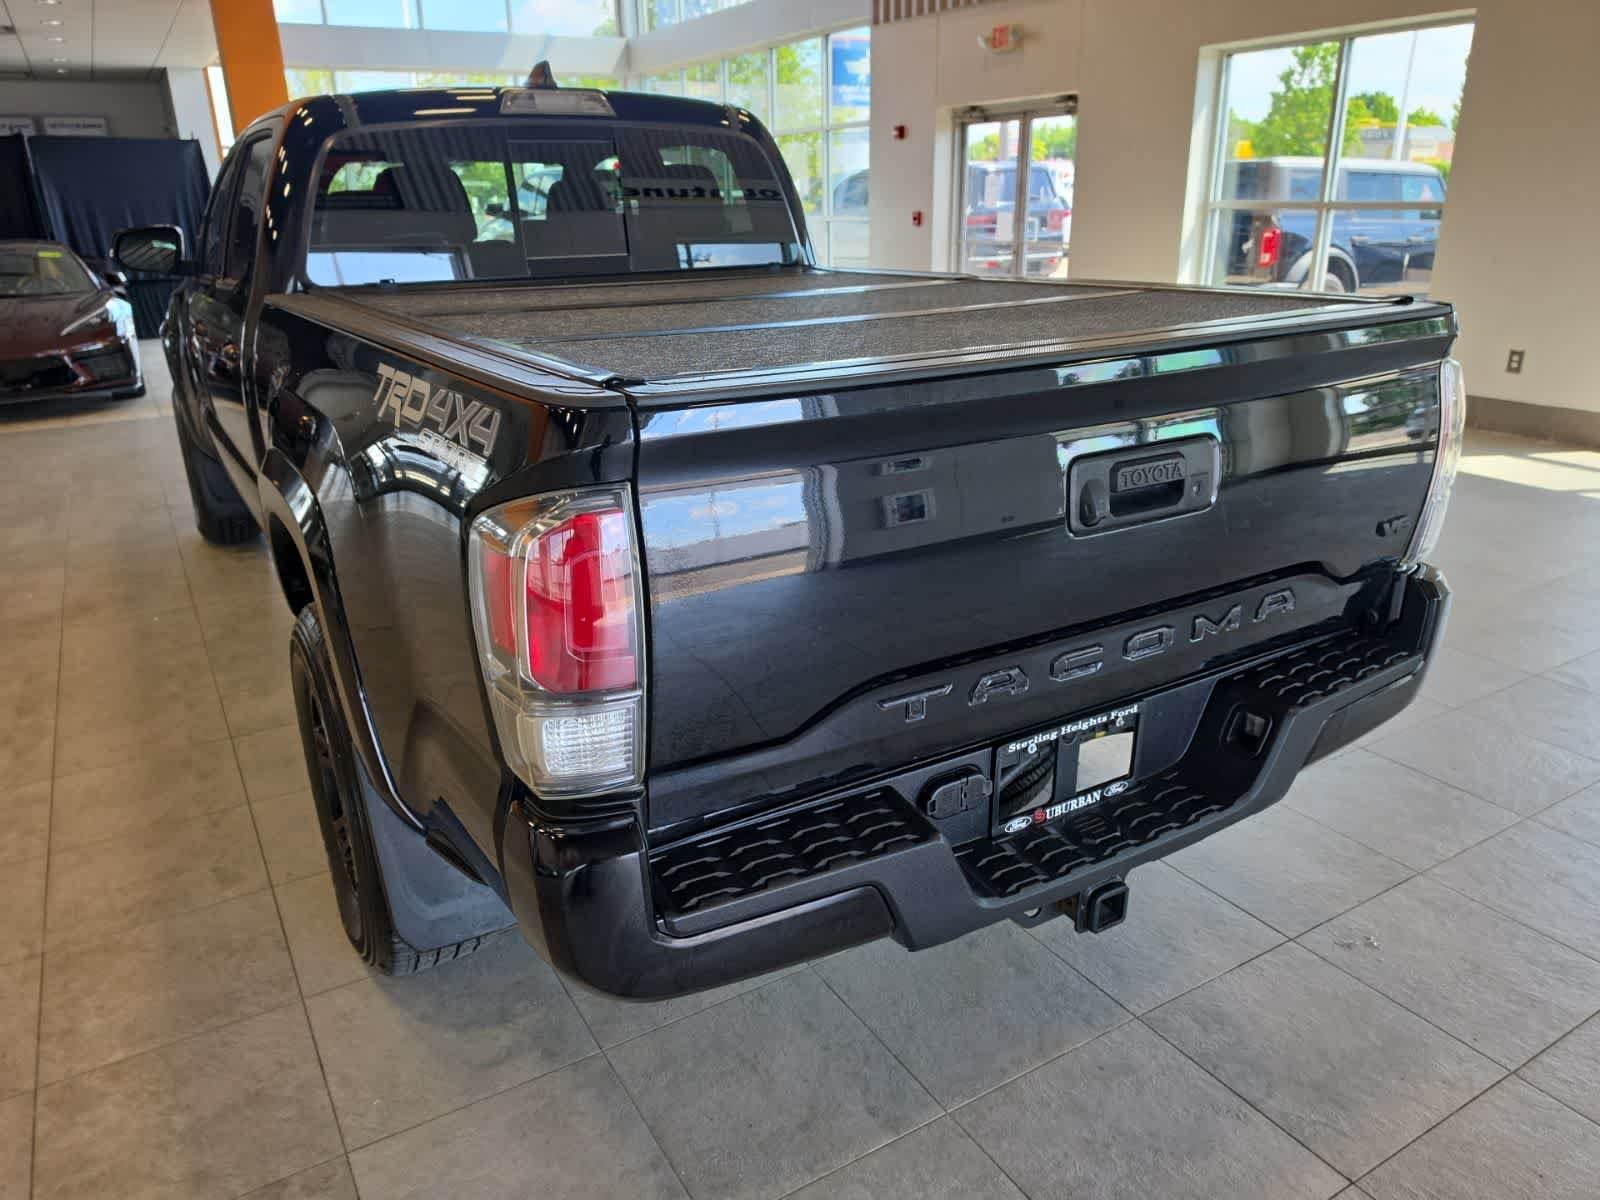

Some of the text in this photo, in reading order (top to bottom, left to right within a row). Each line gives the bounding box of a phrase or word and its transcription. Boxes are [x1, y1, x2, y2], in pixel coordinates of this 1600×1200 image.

[372, 362, 431, 431] TRD
[1121, 462, 1183, 488] TOYOTA
[875, 588, 1297, 723] TACOMA
[1008, 704, 1138, 753] Sterling Heights Ford
[1033, 790, 1102, 824] SUBURBAN
